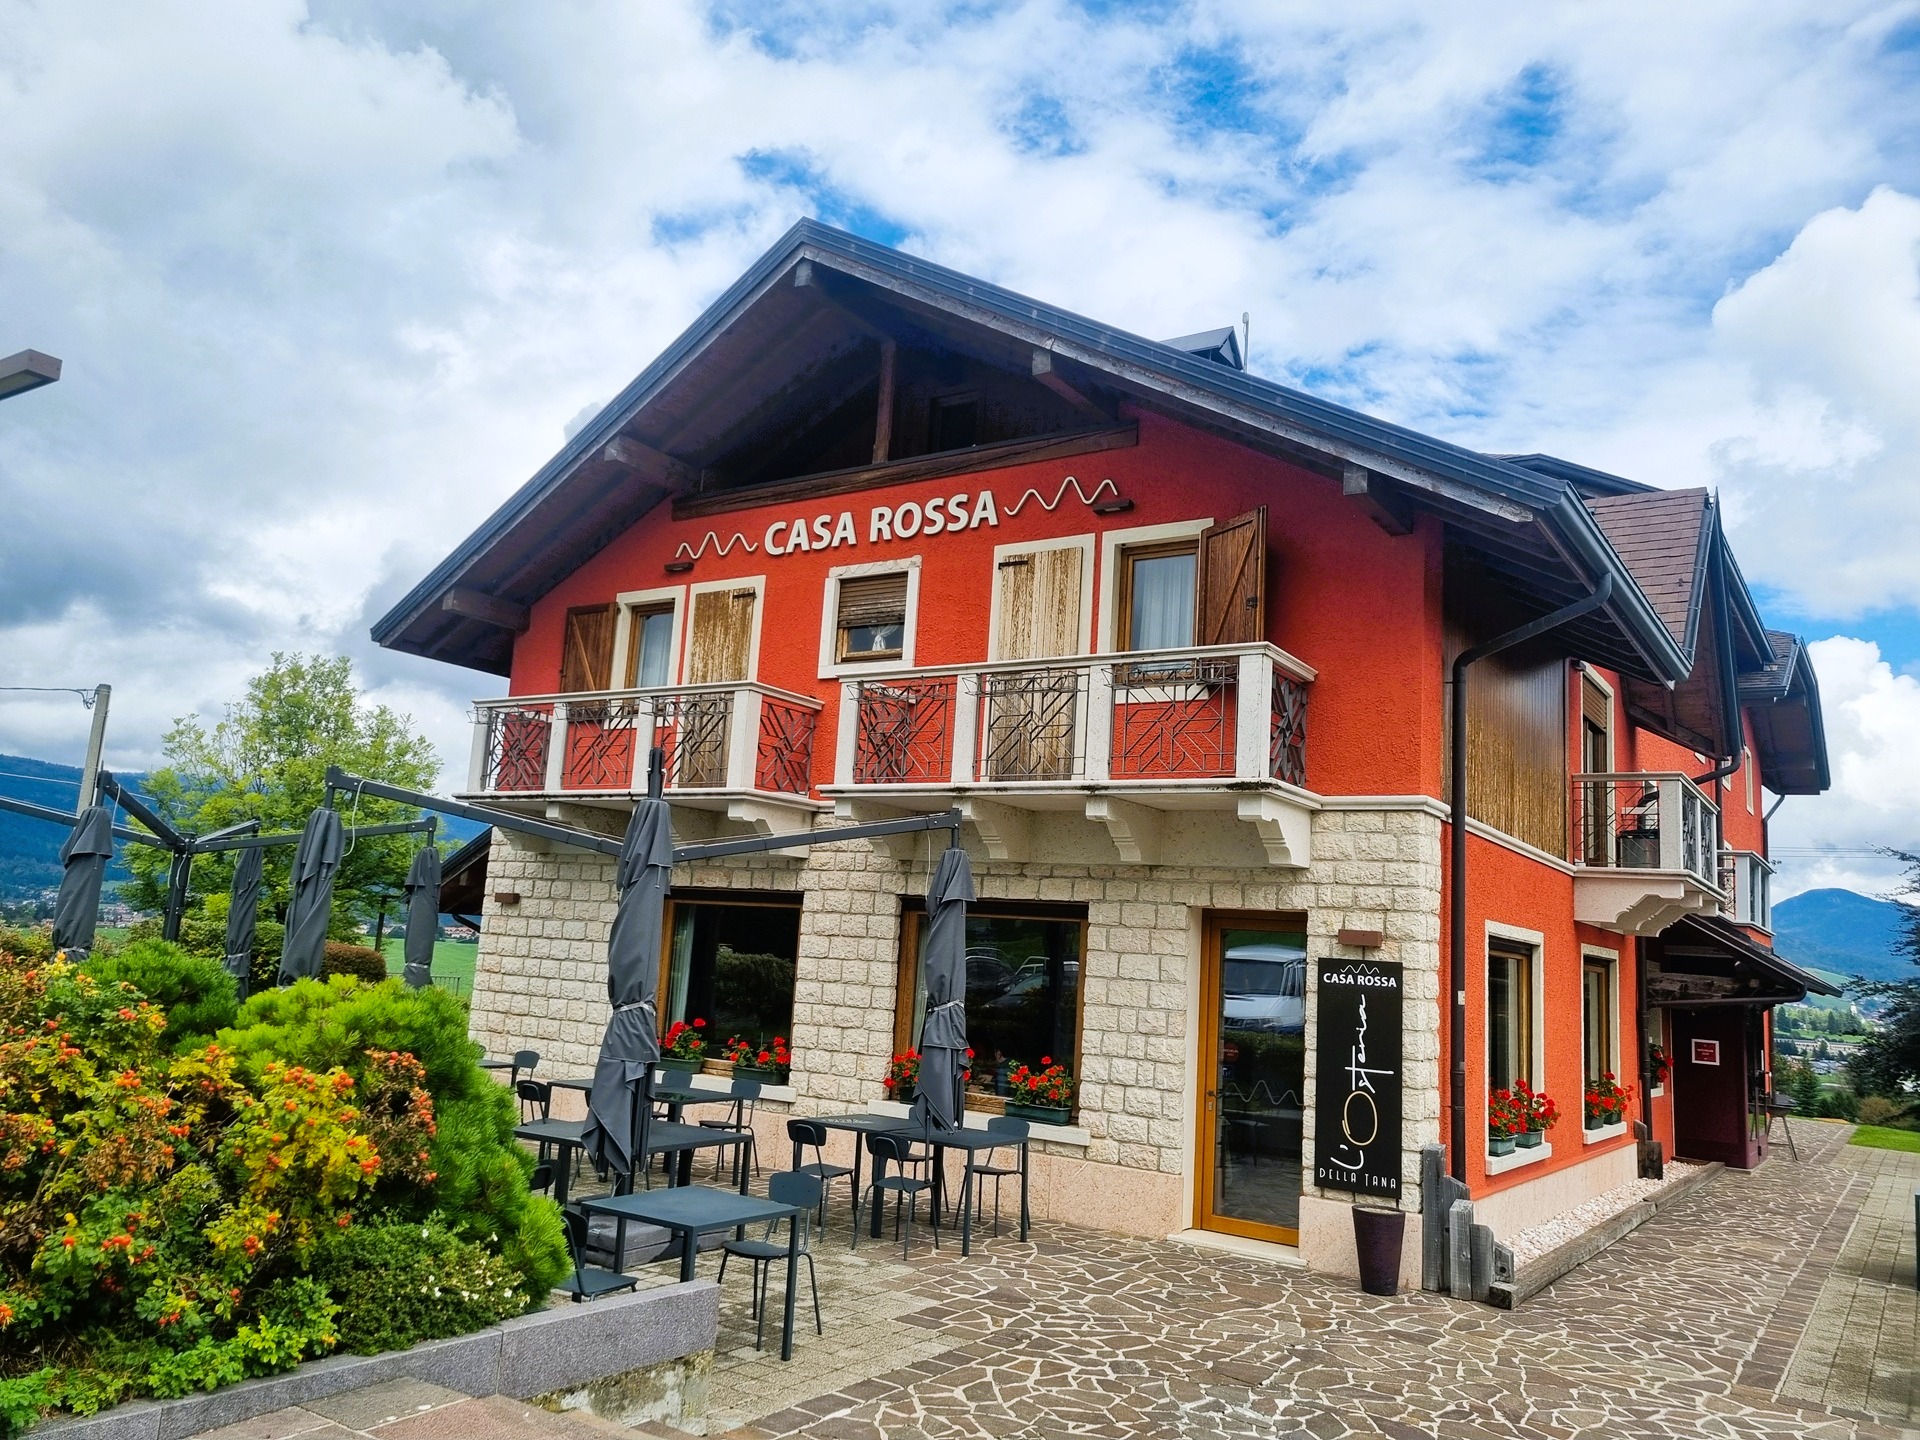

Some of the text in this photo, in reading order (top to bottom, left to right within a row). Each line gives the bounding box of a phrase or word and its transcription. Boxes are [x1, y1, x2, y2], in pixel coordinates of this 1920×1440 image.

[764, 490, 999, 556] CASA ROSSA
[1323, 972, 1397, 988] CASA ROSSA
[1319, 1167, 1397, 1189] DELLA TANA
